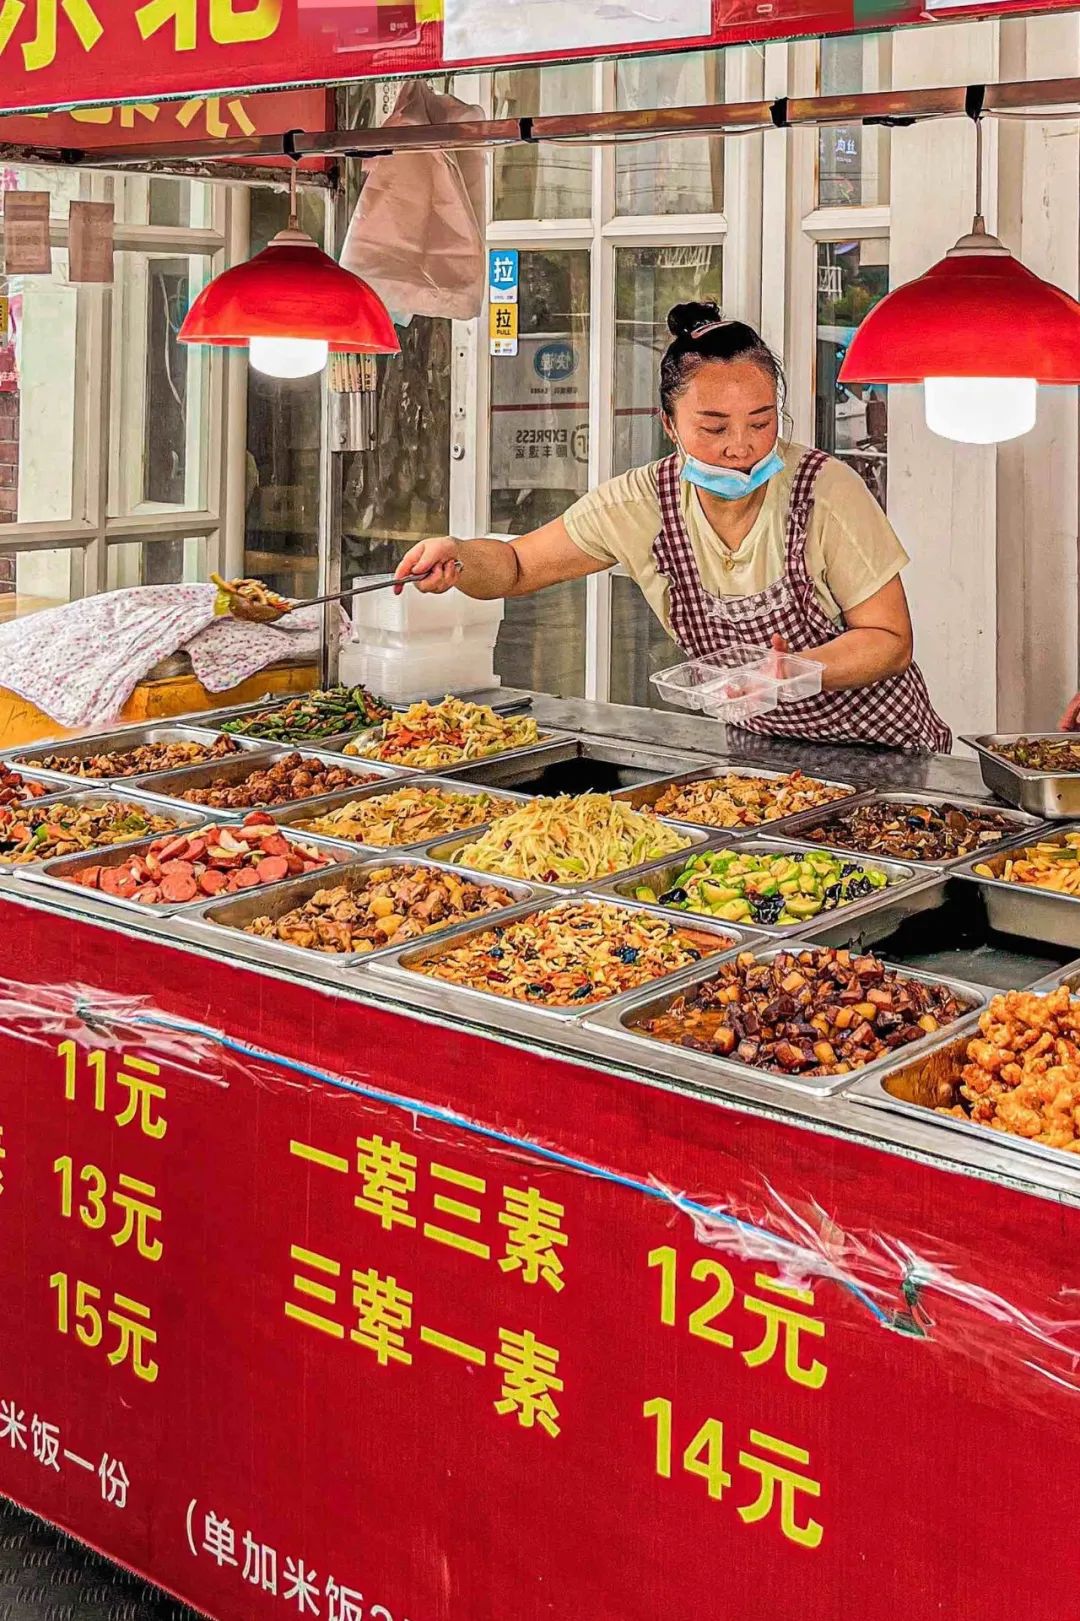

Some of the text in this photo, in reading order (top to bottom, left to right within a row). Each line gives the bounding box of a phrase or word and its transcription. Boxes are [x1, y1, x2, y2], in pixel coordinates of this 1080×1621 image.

[494, 256, 514, 283] 拉
[496, 308, 512, 328] 拉
[58, 1040, 167, 1139] 11元
[53, 1156, 163, 1261] 13元
[290, 1136, 828, 1389] 一荤三素 12元
[50, 1273, 159, 1382] 15元
[284, 1246, 824, 1548] 三荤一素 14元
[0, 1399, 130, 1508] 米饭一份
